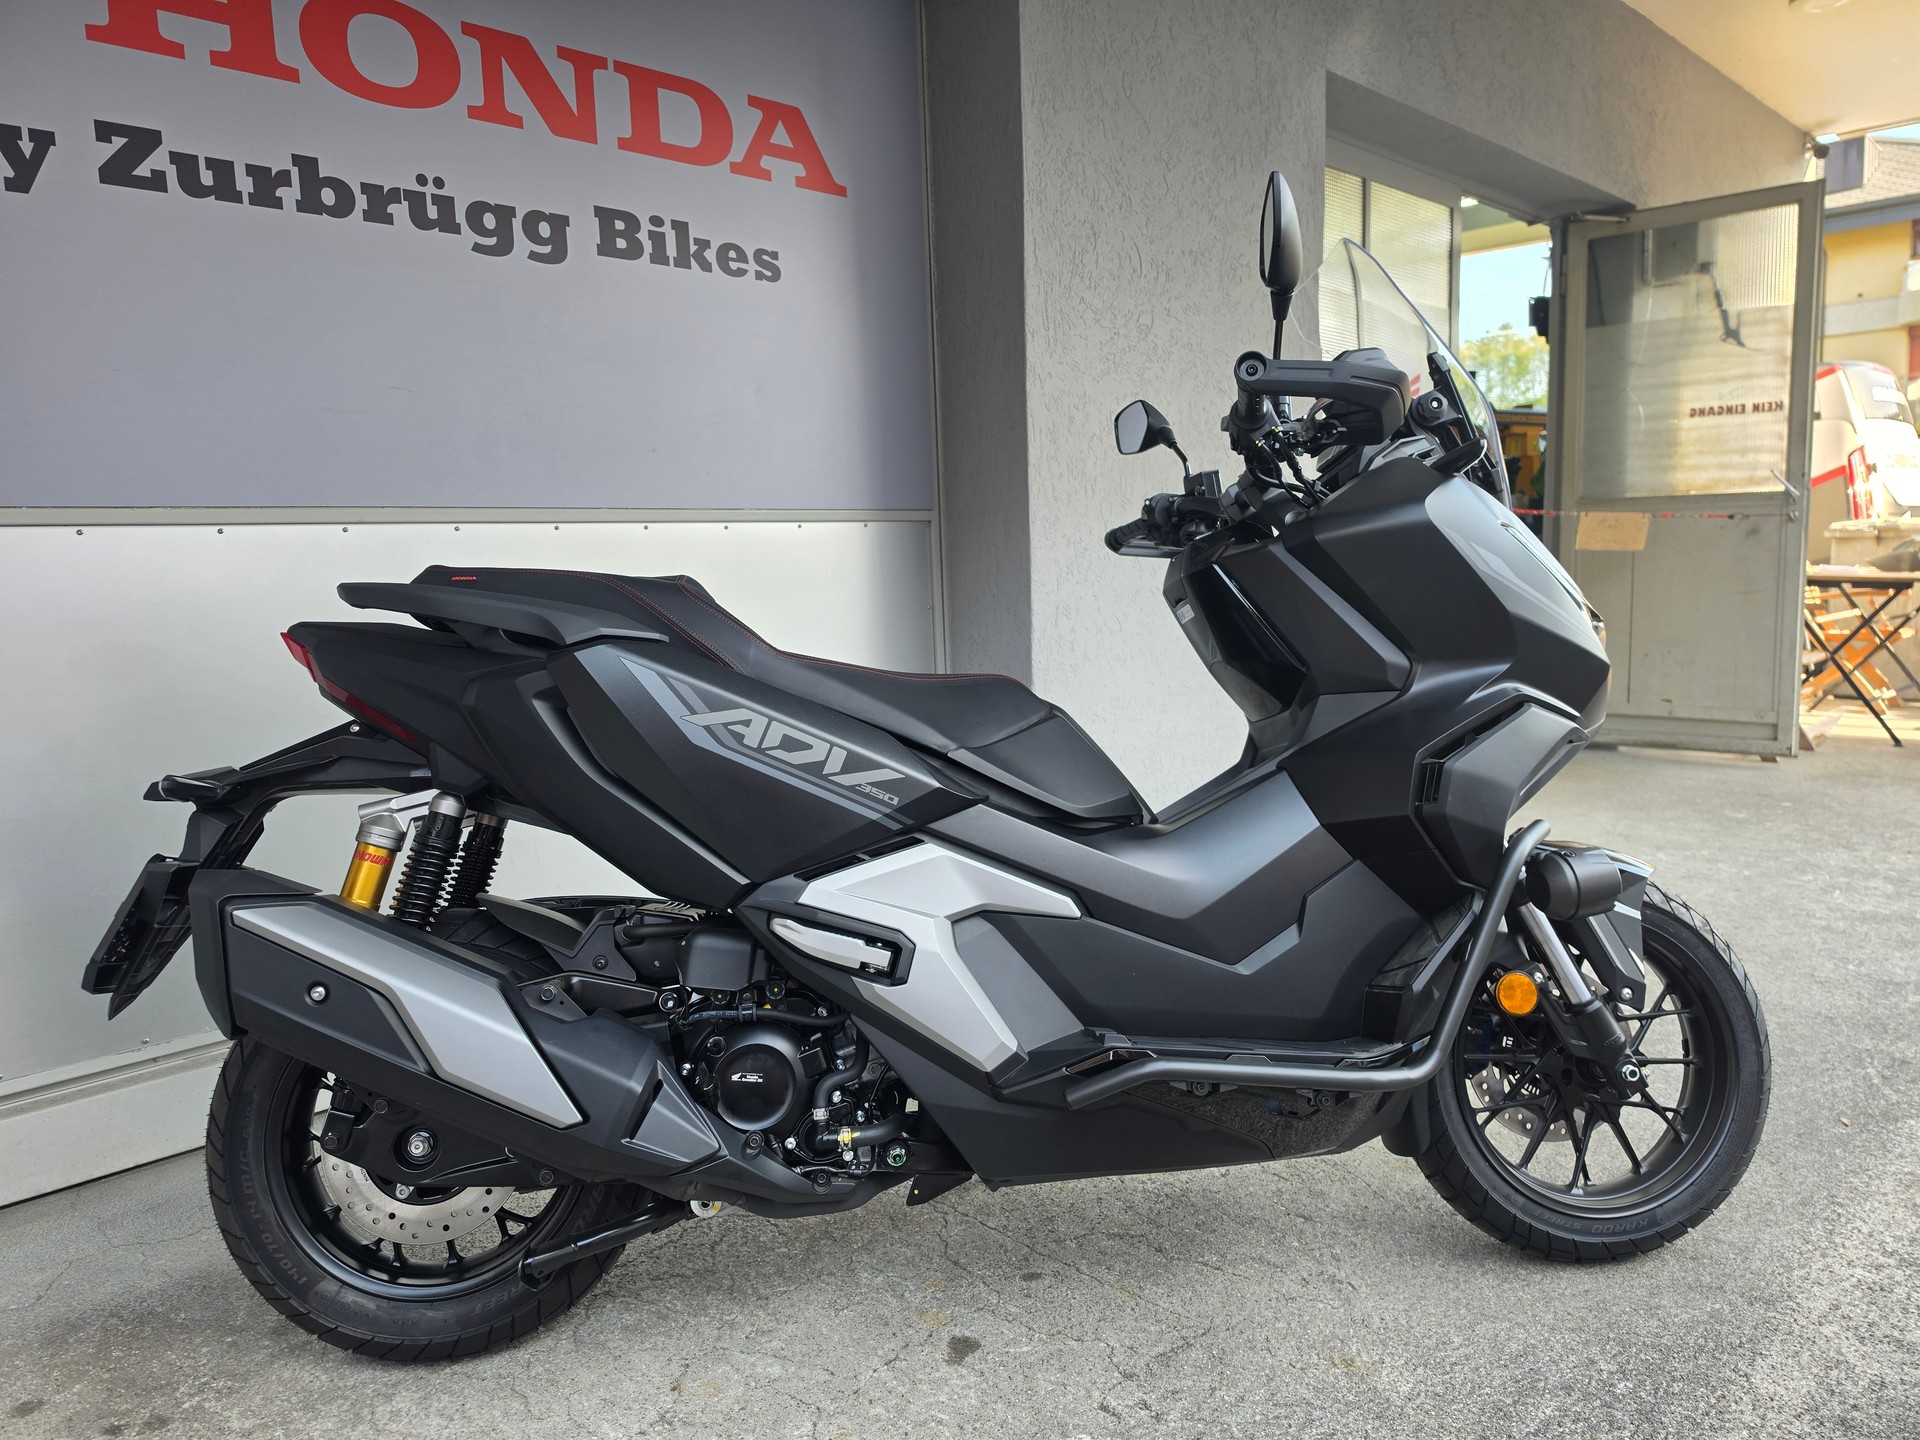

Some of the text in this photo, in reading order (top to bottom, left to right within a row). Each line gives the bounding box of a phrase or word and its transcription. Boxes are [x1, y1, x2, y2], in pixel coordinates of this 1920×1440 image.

[84, 0, 848, 197] HONDA
[94, 119, 570, 265] Zurbrügg
[594, 205, 782, 284] Bikes
[680, 708, 905, 786] ADV
[855, 783, 899, 806] 350
[1533, 1210, 1648, 1234] KAROO STREET
